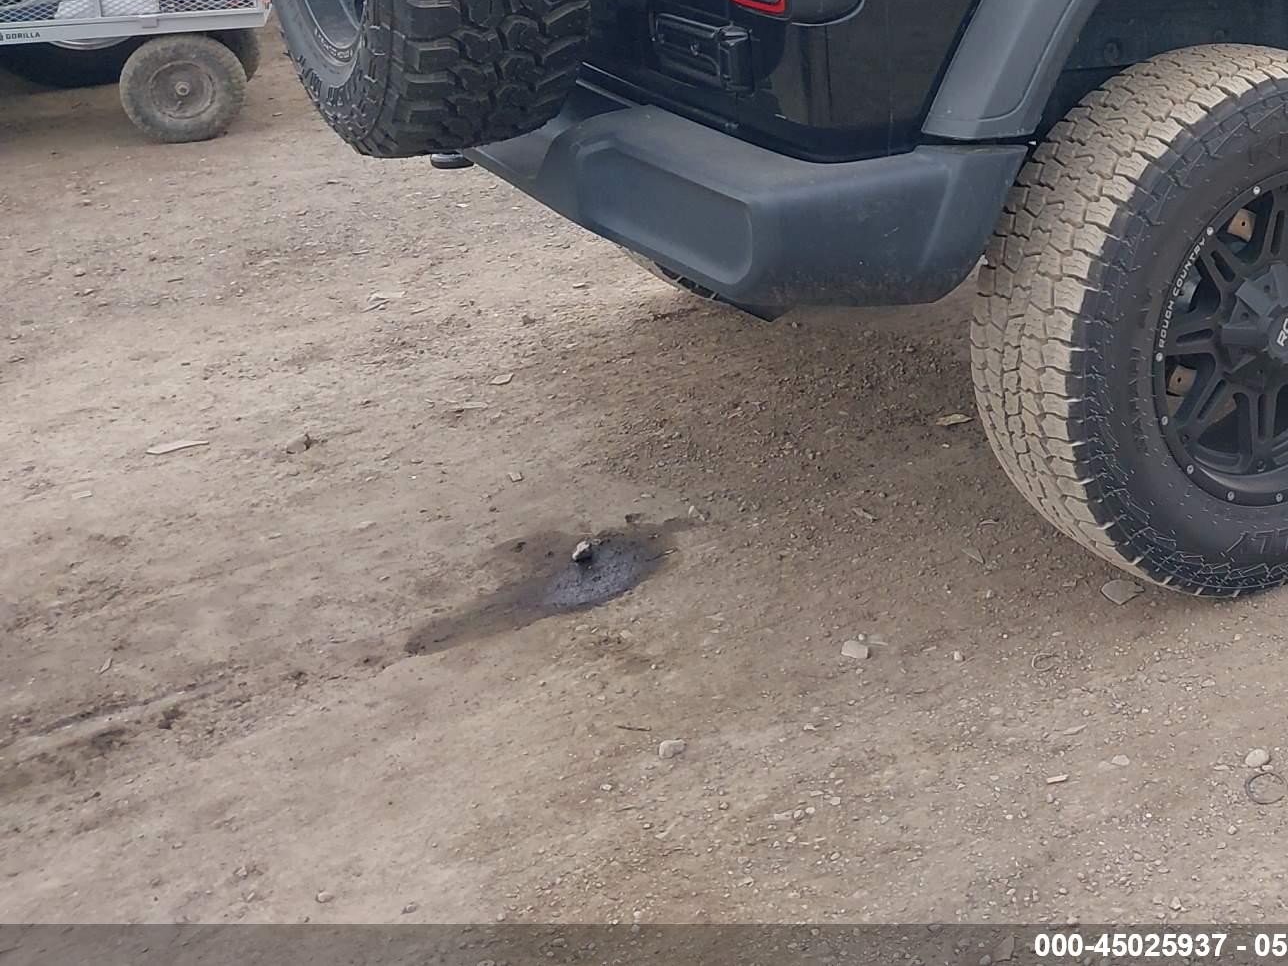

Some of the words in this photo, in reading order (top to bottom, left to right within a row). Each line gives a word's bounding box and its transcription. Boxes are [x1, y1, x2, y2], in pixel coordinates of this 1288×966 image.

[5, 31, 41, 40] GORILLA
[1158, 300, 1175, 349] ROUGH
[1172, 237, 1206, 297] COUNTRY
